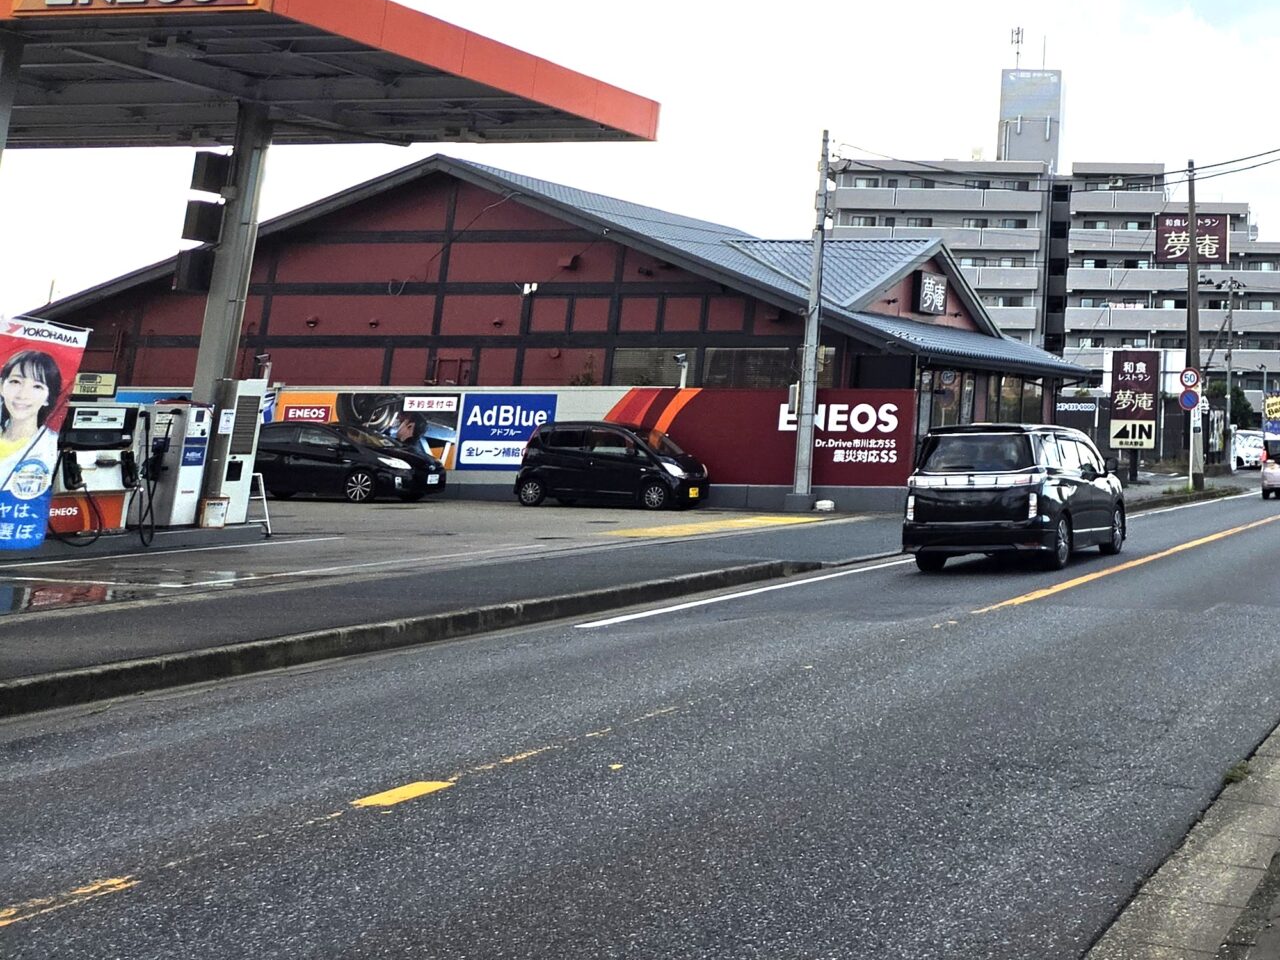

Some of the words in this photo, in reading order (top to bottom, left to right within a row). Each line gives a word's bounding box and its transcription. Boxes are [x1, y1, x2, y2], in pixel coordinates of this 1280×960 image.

[1165, 218, 1220, 227] 和食レトラン
[922, 276, 946, 312] 夢庵
[22, 325, 79, 345] YOKOHAMA
[1123, 361, 1147, 374] 和食
[1118, 374, 1151, 382] レストラン
[1184, 373, 1196, 383] 50
[407, 399, 454, 408] 予約受付中
[1114, 389, 1154, 412] 夢庵
[288, 408, 326, 419] ENEOS
[466, 405, 548, 426] AdBlue
[778, 403, 899, 433] ENEOS
[490, 428, 523, 437] アドブルー
[1131, 423, 1153, 440] IN
[832, 449, 898, 463] 震災対応SS
[49, 507, 78, 517] ENEOS
